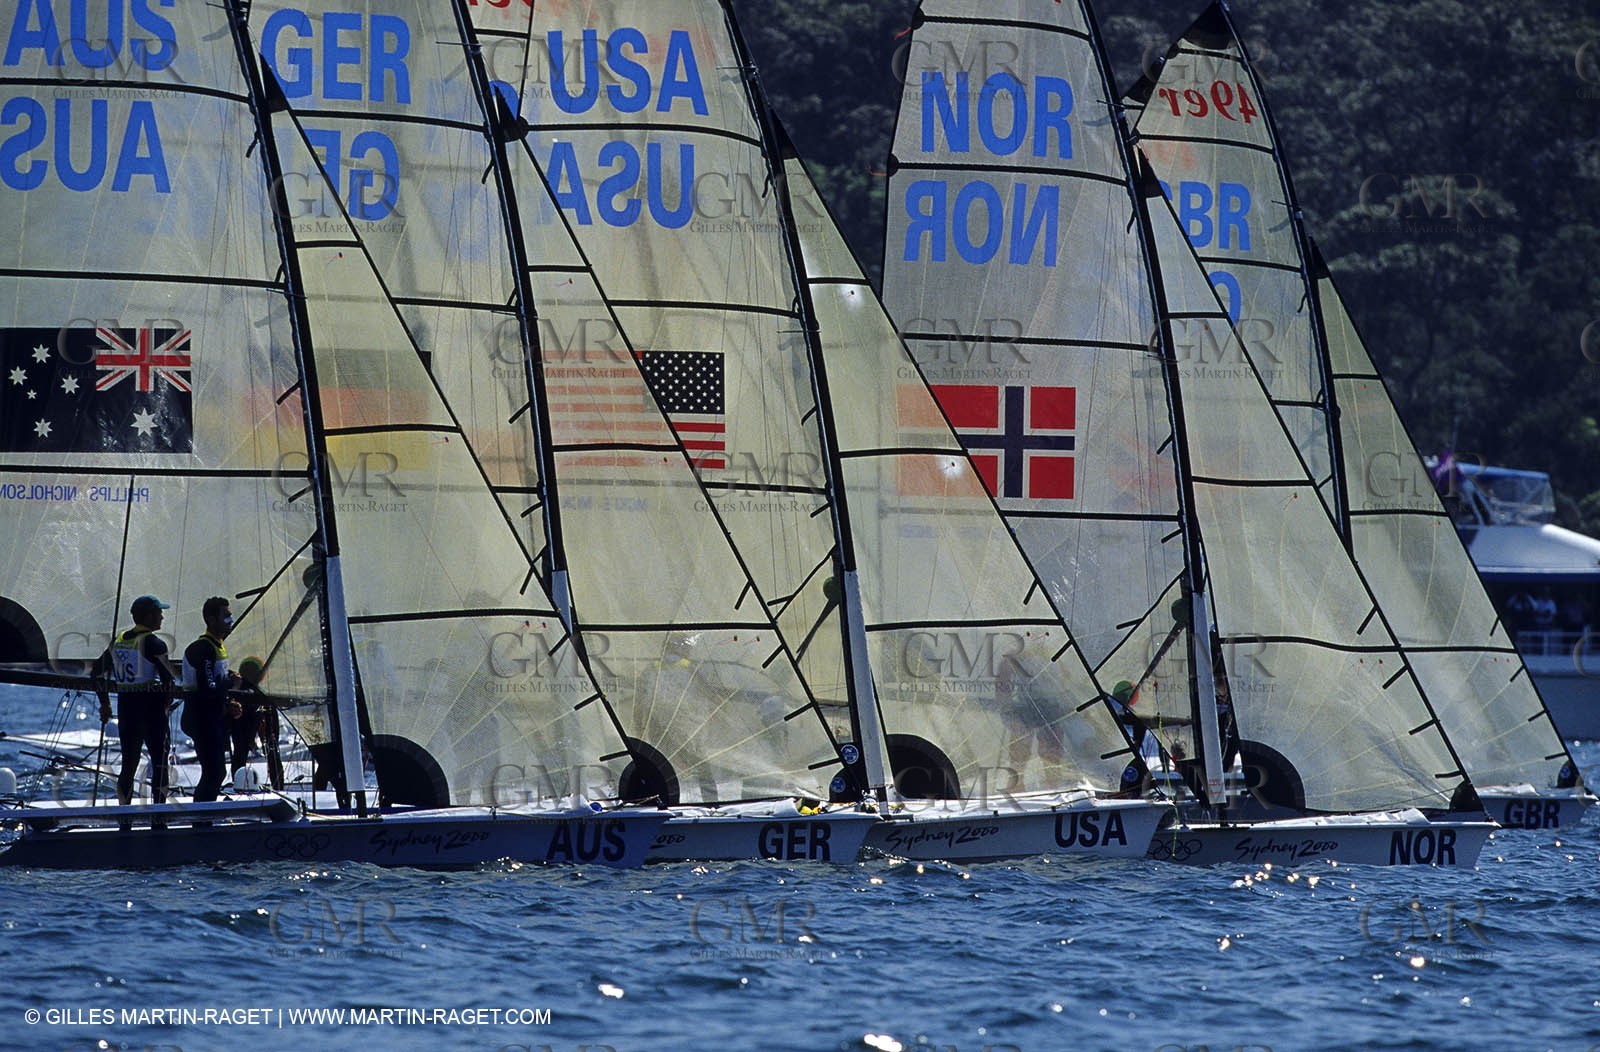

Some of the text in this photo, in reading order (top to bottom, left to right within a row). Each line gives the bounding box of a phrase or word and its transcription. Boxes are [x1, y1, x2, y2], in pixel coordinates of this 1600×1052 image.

[3, 0, 178, 72] AUS
[260, 9, 411, 105] GER
[548, 29, 709, 116] USA
[921, 71, 1074, 160] NOR
[1159, 179, 1251, 251] BR
[1055, 811, 1128, 848] USA
[1504, 799, 1560, 829] GBR
[369, 829, 490, 856] Sydney 2000
[546, 822, 626, 863] AUS
[759, 822, 832, 861] GER
[885, 825, 999, 851] Sydney 2000
[1234, 838, 1339, 862] Sydney 2000
[1389, 829, 1457, 866] NOR
